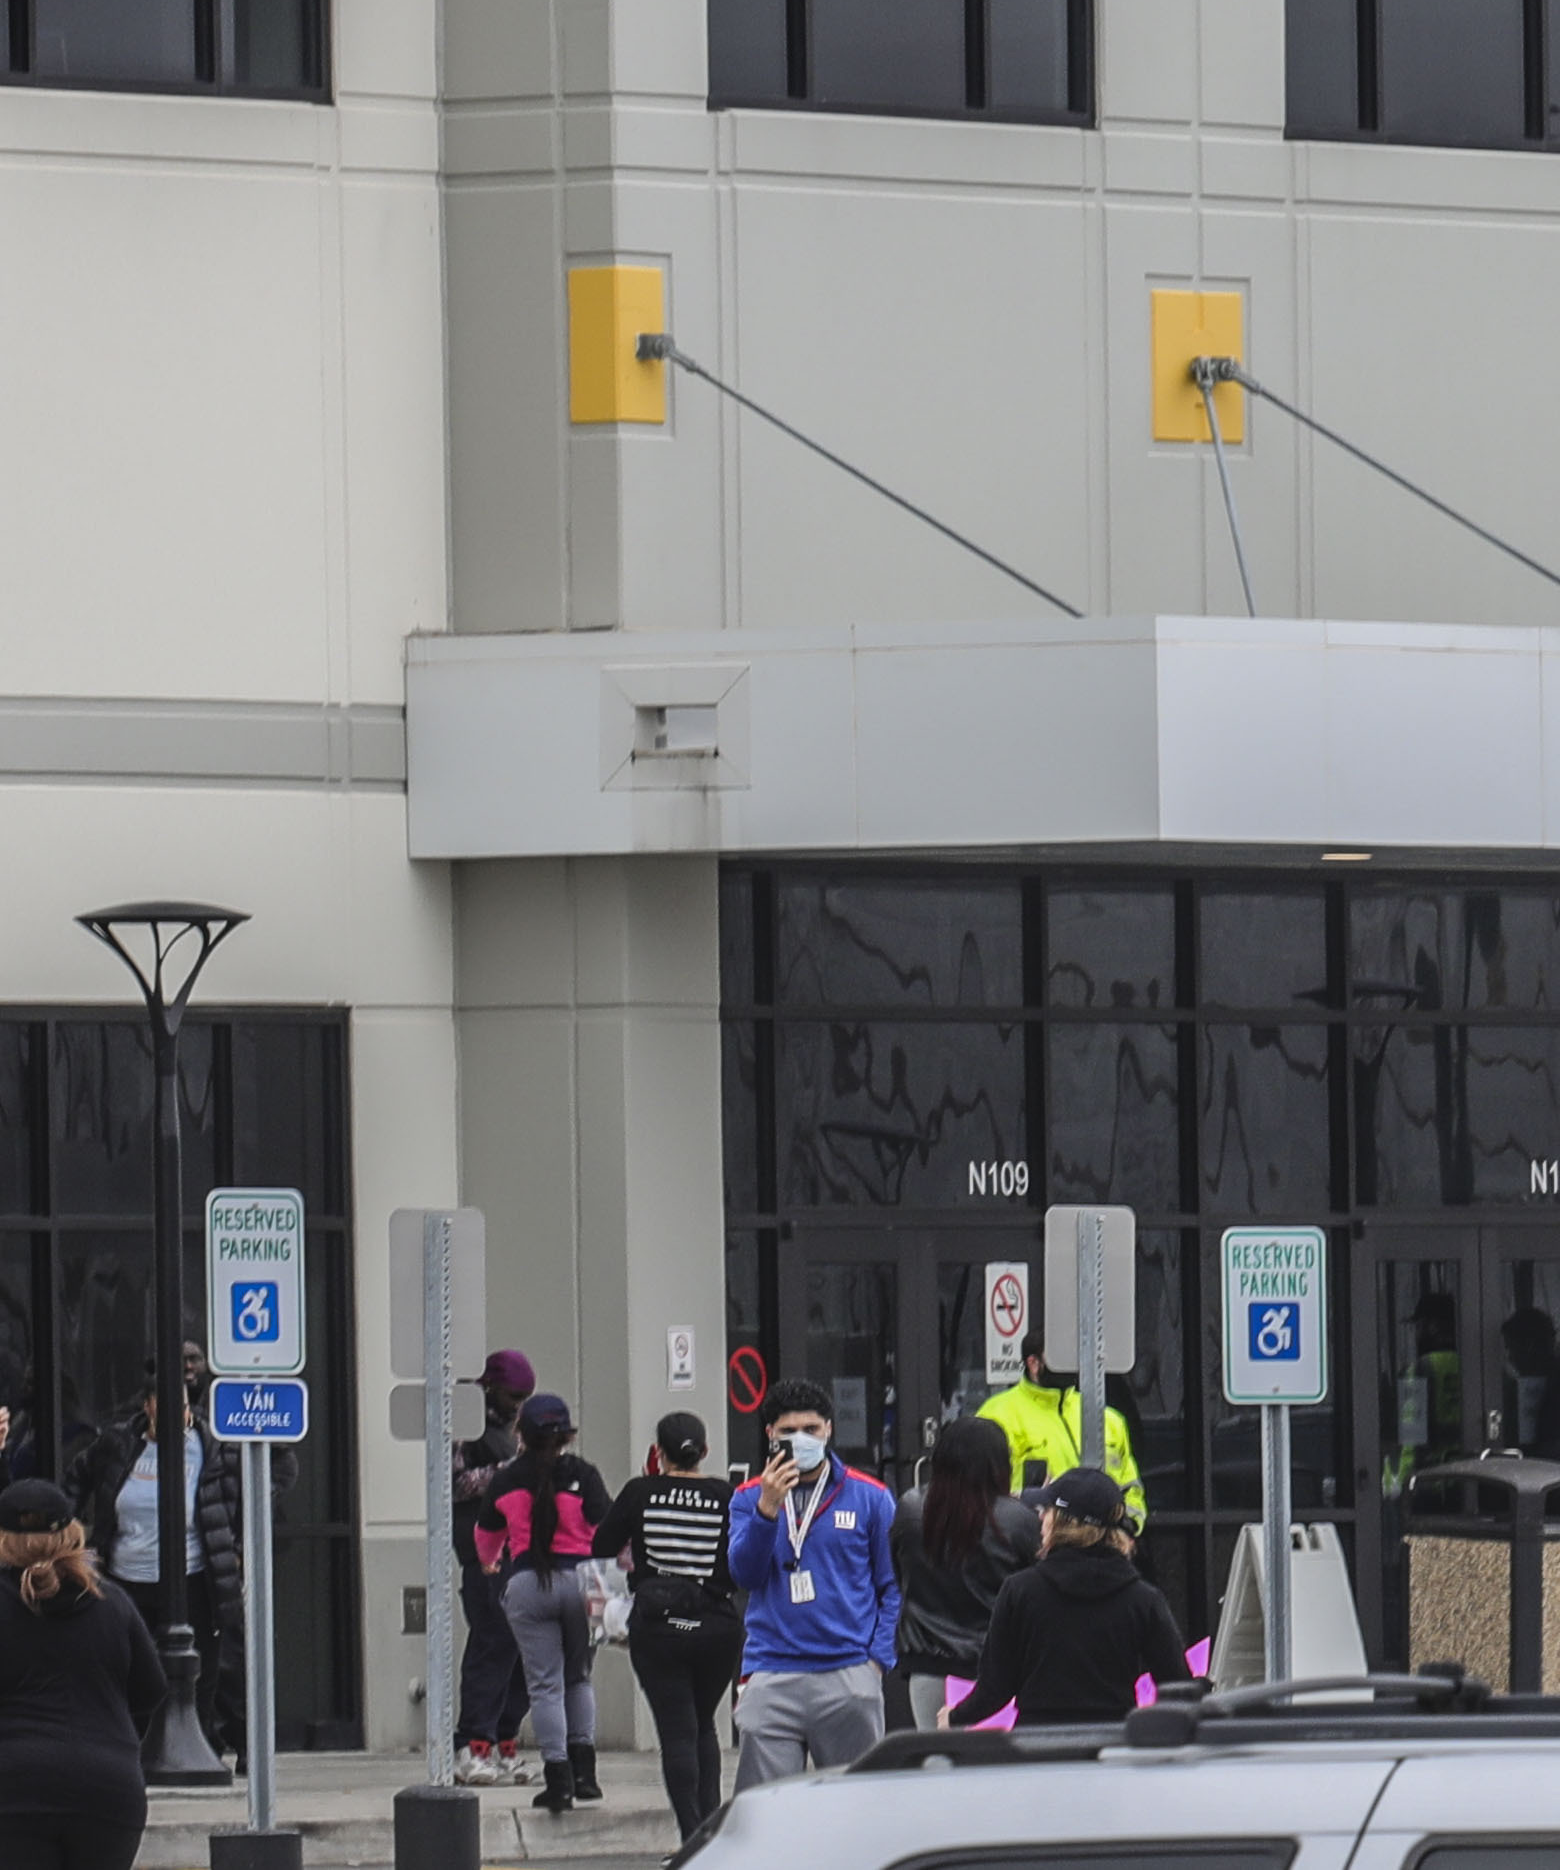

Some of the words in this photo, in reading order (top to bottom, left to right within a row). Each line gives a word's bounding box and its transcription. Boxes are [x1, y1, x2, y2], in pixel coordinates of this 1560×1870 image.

[968, 1160, 1029, 1196] N109
[214, 1207, 296, 1230] RESERVED
[219, 1237, 291, 1261] PARKING
[1232, 1244, 1315, 1269] RESERVED
[1240, 1271, 1308, 1297] PARKING
[242, 1392, 274, 1411] VAN
[226, 1411, 291, 1427] ACCESSIBLE
